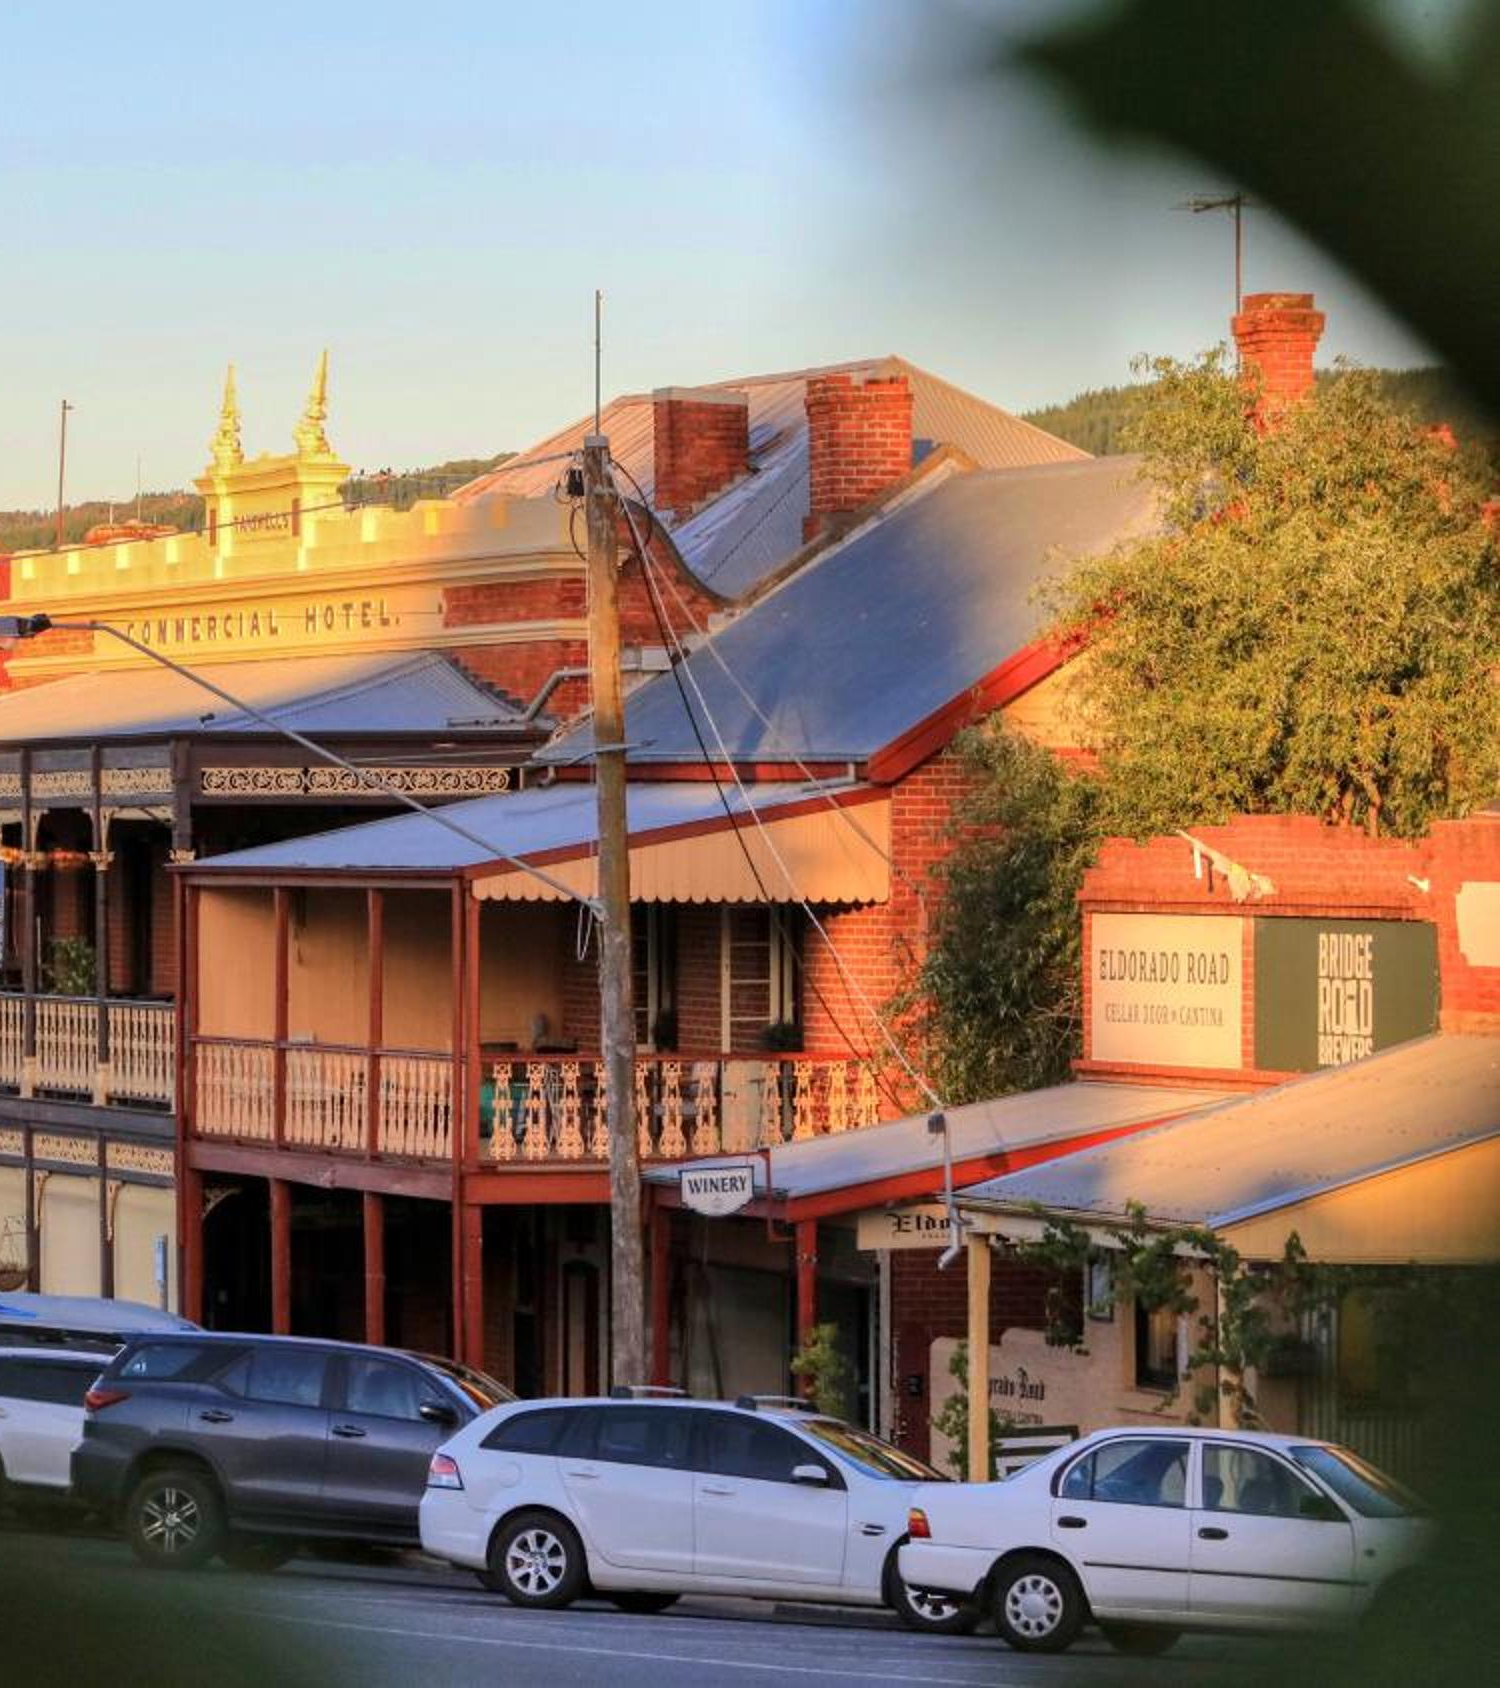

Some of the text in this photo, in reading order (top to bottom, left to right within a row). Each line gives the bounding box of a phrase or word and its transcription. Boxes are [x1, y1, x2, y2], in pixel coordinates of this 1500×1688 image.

[127, 609, 279, 645] COMMERCIAL
[1099, 949, 1230, 985] ELDORADO ROAD
[1319, 933, 1373, 979] BRIDGE
[1179, 1006, 1224, 1026] CANTINA
[688, 1175, 747, 1195] WINERY
